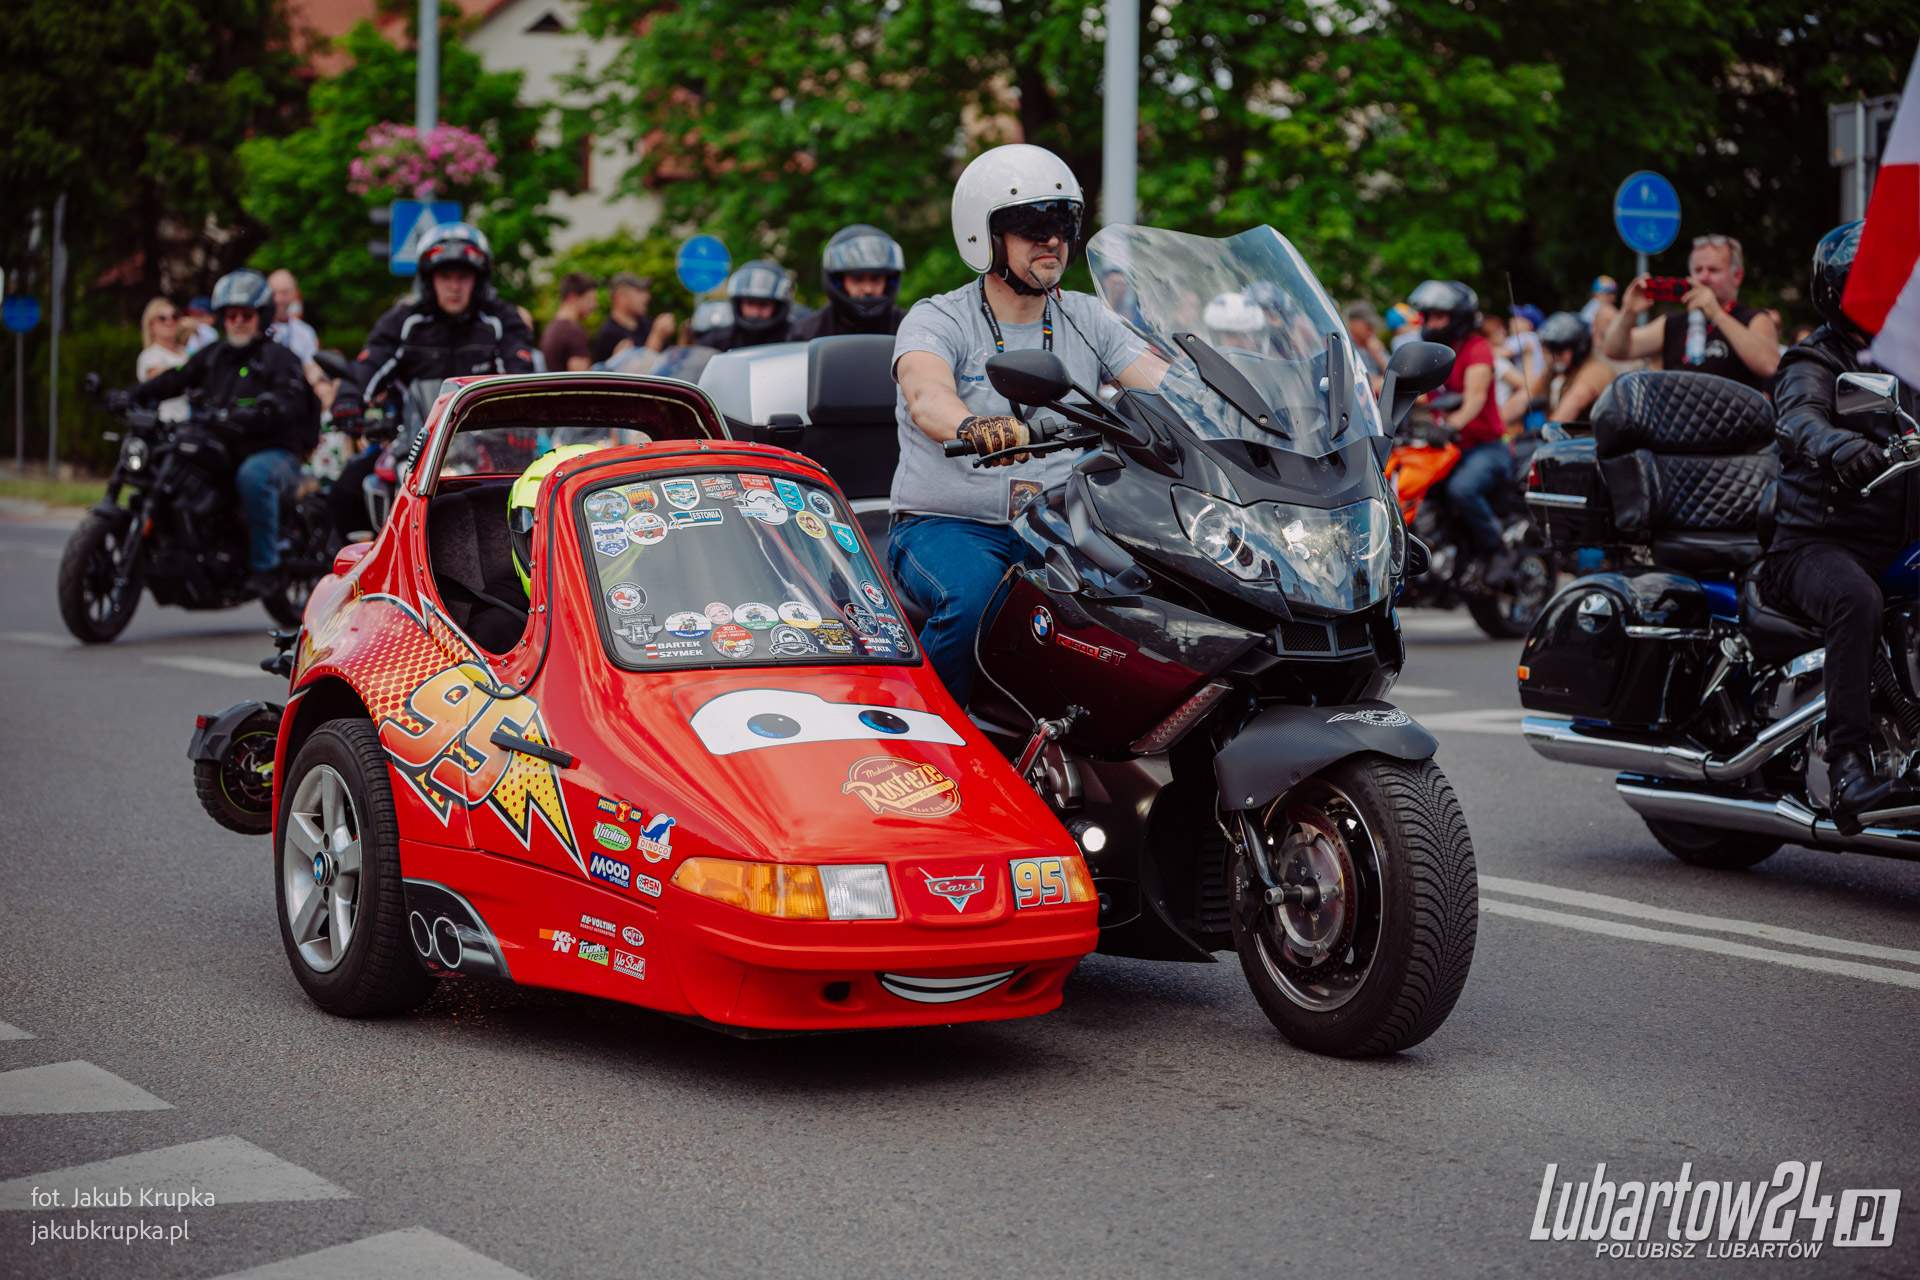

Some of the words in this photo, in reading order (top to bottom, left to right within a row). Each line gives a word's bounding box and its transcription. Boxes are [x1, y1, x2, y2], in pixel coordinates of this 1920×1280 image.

[692, 511, 720, 520] ESTONIA
[657, 641, 701, 650] BARTEK
[659, 649, 704, 658] SZYMEK
[379, 663, 538, 805] 95
[598, 798, 617, 812] PISTON
[631, 809, 642, 819] CUP
[593, 821, 629, 846] Vitoline
[639, 840, 669, 856] DINOCO
[590, 855, 630, 880] MOOD
[644, 879, 660, 891] RSN
[934, 881, 979, 894] Cars
[1014, 861, 1065, 909] 95
